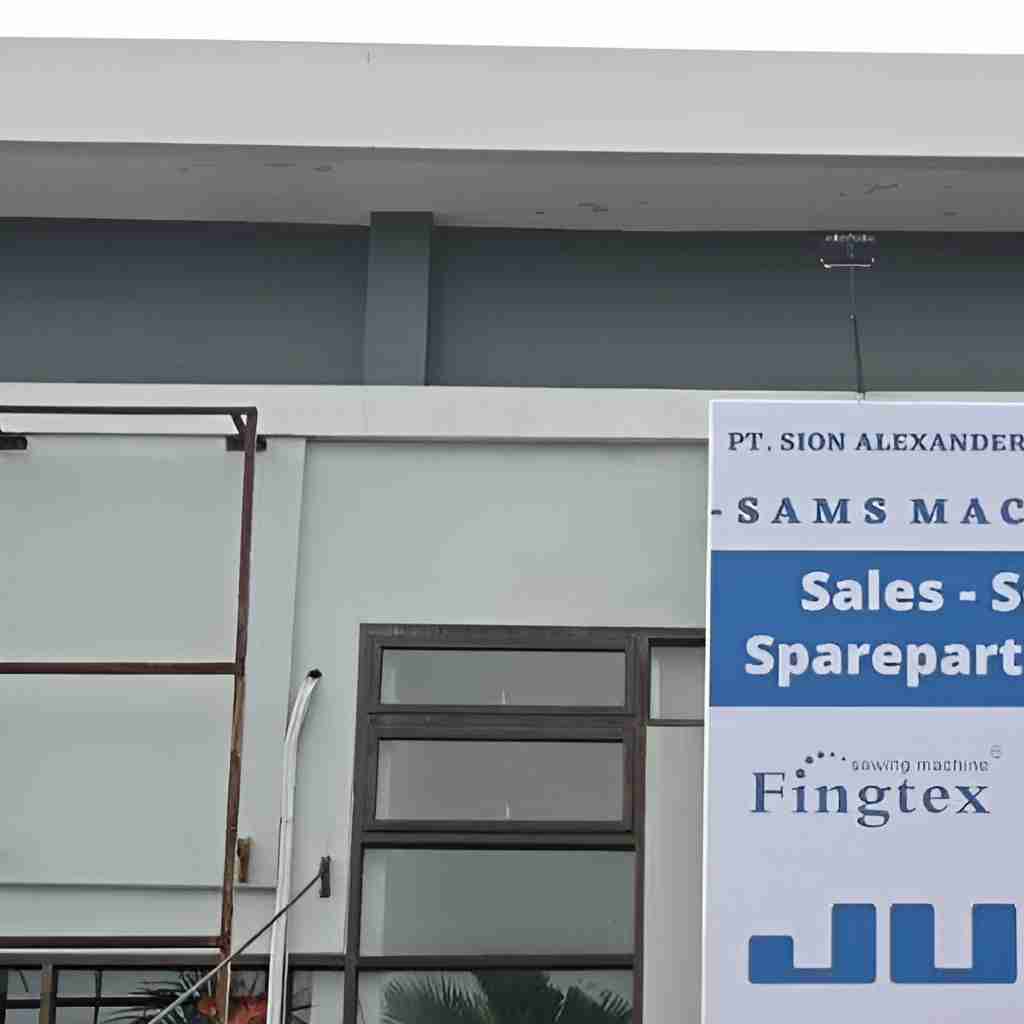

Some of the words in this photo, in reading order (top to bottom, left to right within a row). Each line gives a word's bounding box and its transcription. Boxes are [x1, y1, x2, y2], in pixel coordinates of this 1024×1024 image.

[728, 432, 771, 452] PT.
[781, 432, 845, 452] SION
[737, 496, 887, 525] SAMS
[801, 569, 945, 612] Sales
[744, 634, 1023, 688] Sparepart
[917, 758, 988, 771] machine
[750, 769, 991, 828] Fingtex
